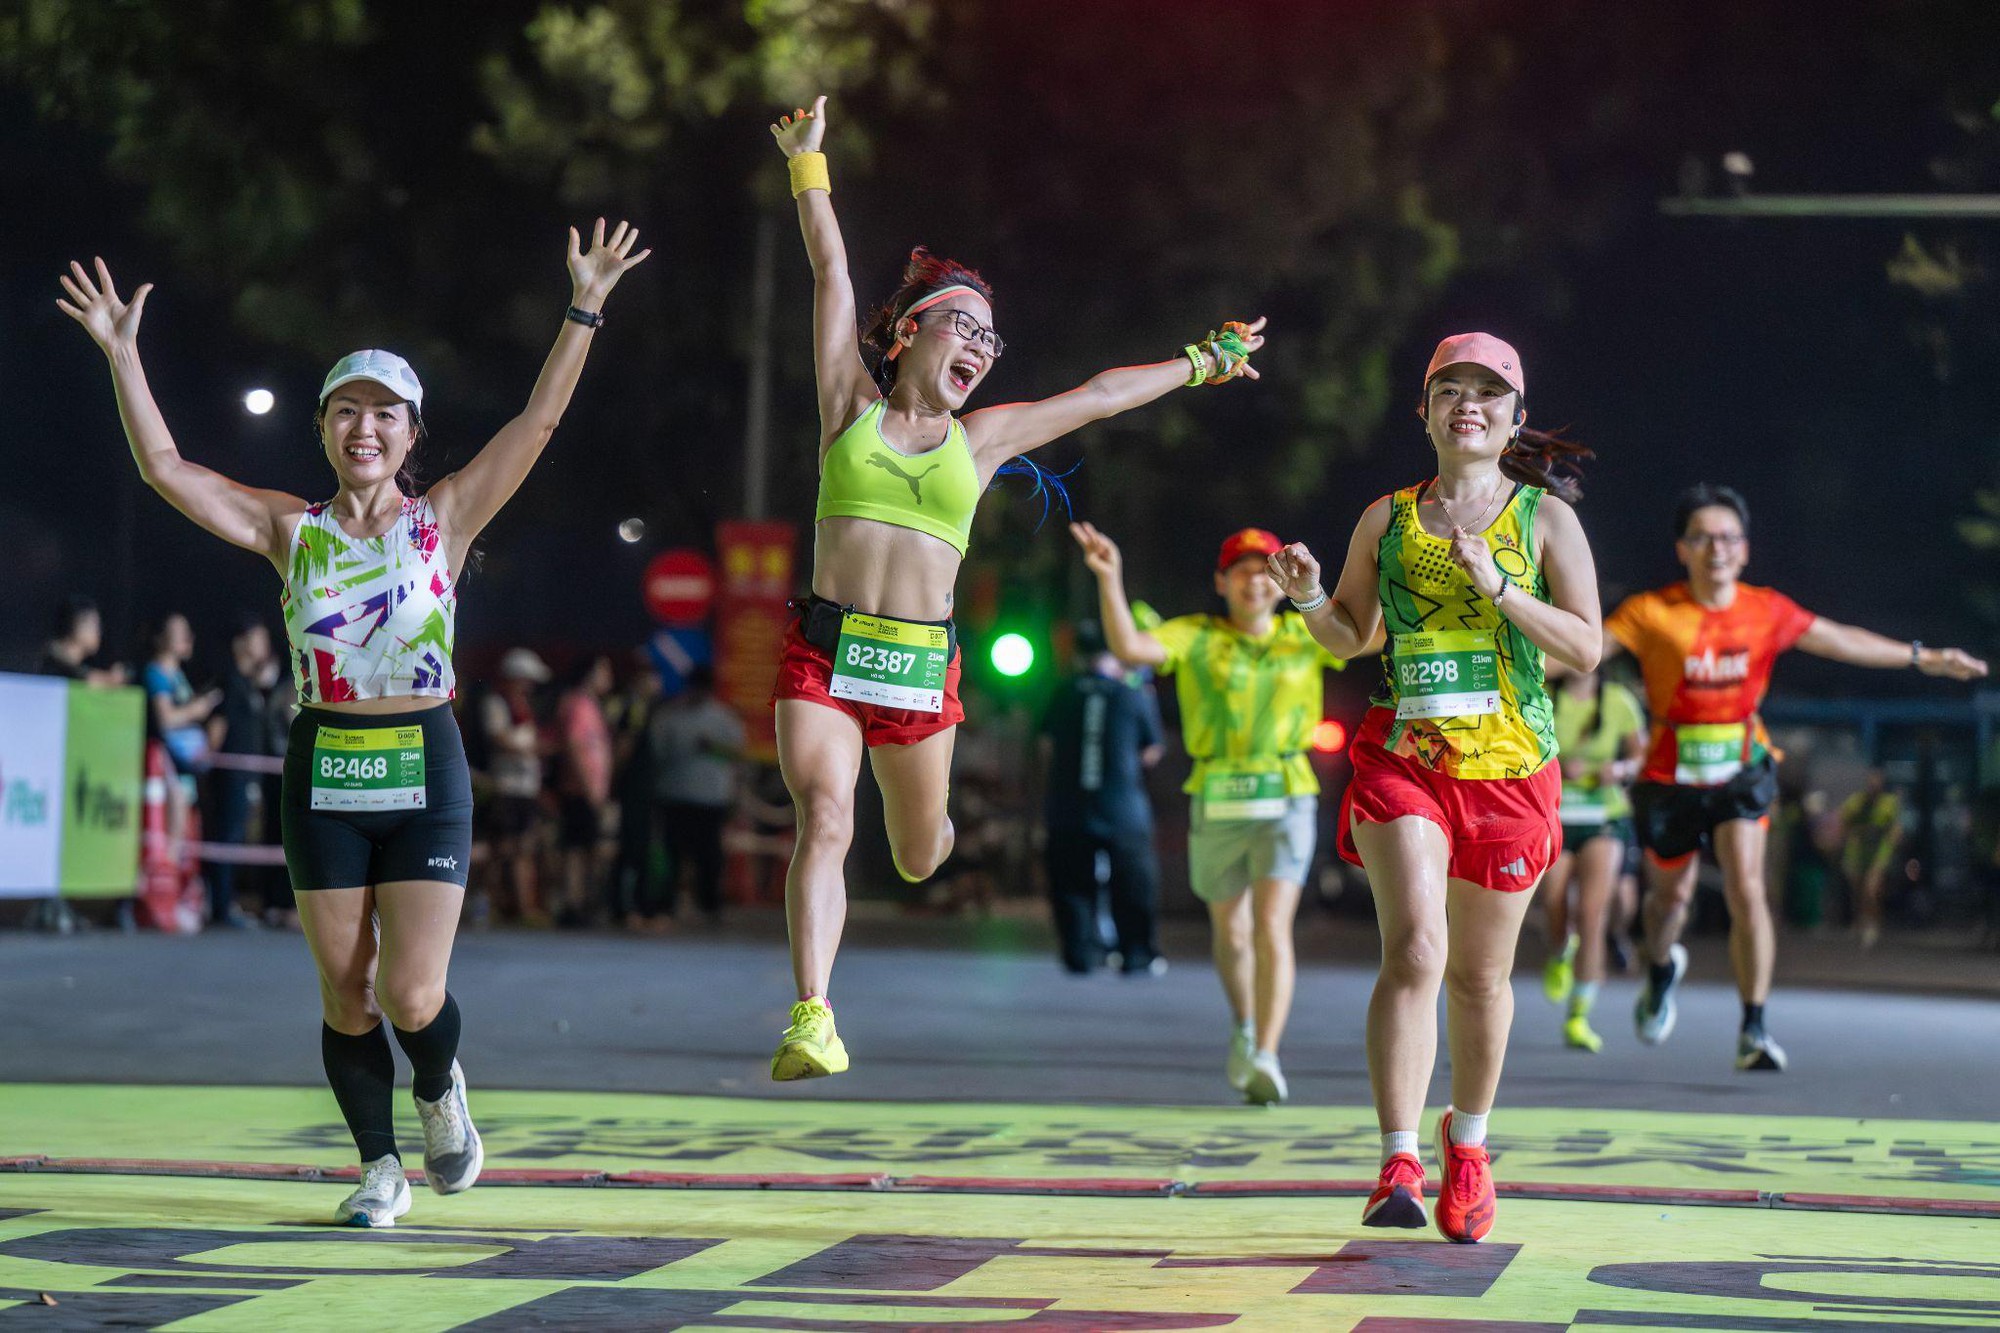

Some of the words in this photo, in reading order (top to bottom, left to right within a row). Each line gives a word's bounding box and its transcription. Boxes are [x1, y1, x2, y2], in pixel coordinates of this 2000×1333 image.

[846, 643, 917, 675] 82387
[927, 652, 945, 662] 21km
[1471, 654, 1492, 663] 21km
[1401, 660, 1459, 686] 82298
[931, 696, 938, 706] F
[1487, 698, 1493, 708] F
[400, 752, 420, 761] 21km
[320, 756, 388, 779] 82468
[413, 793, 420, 803] F
